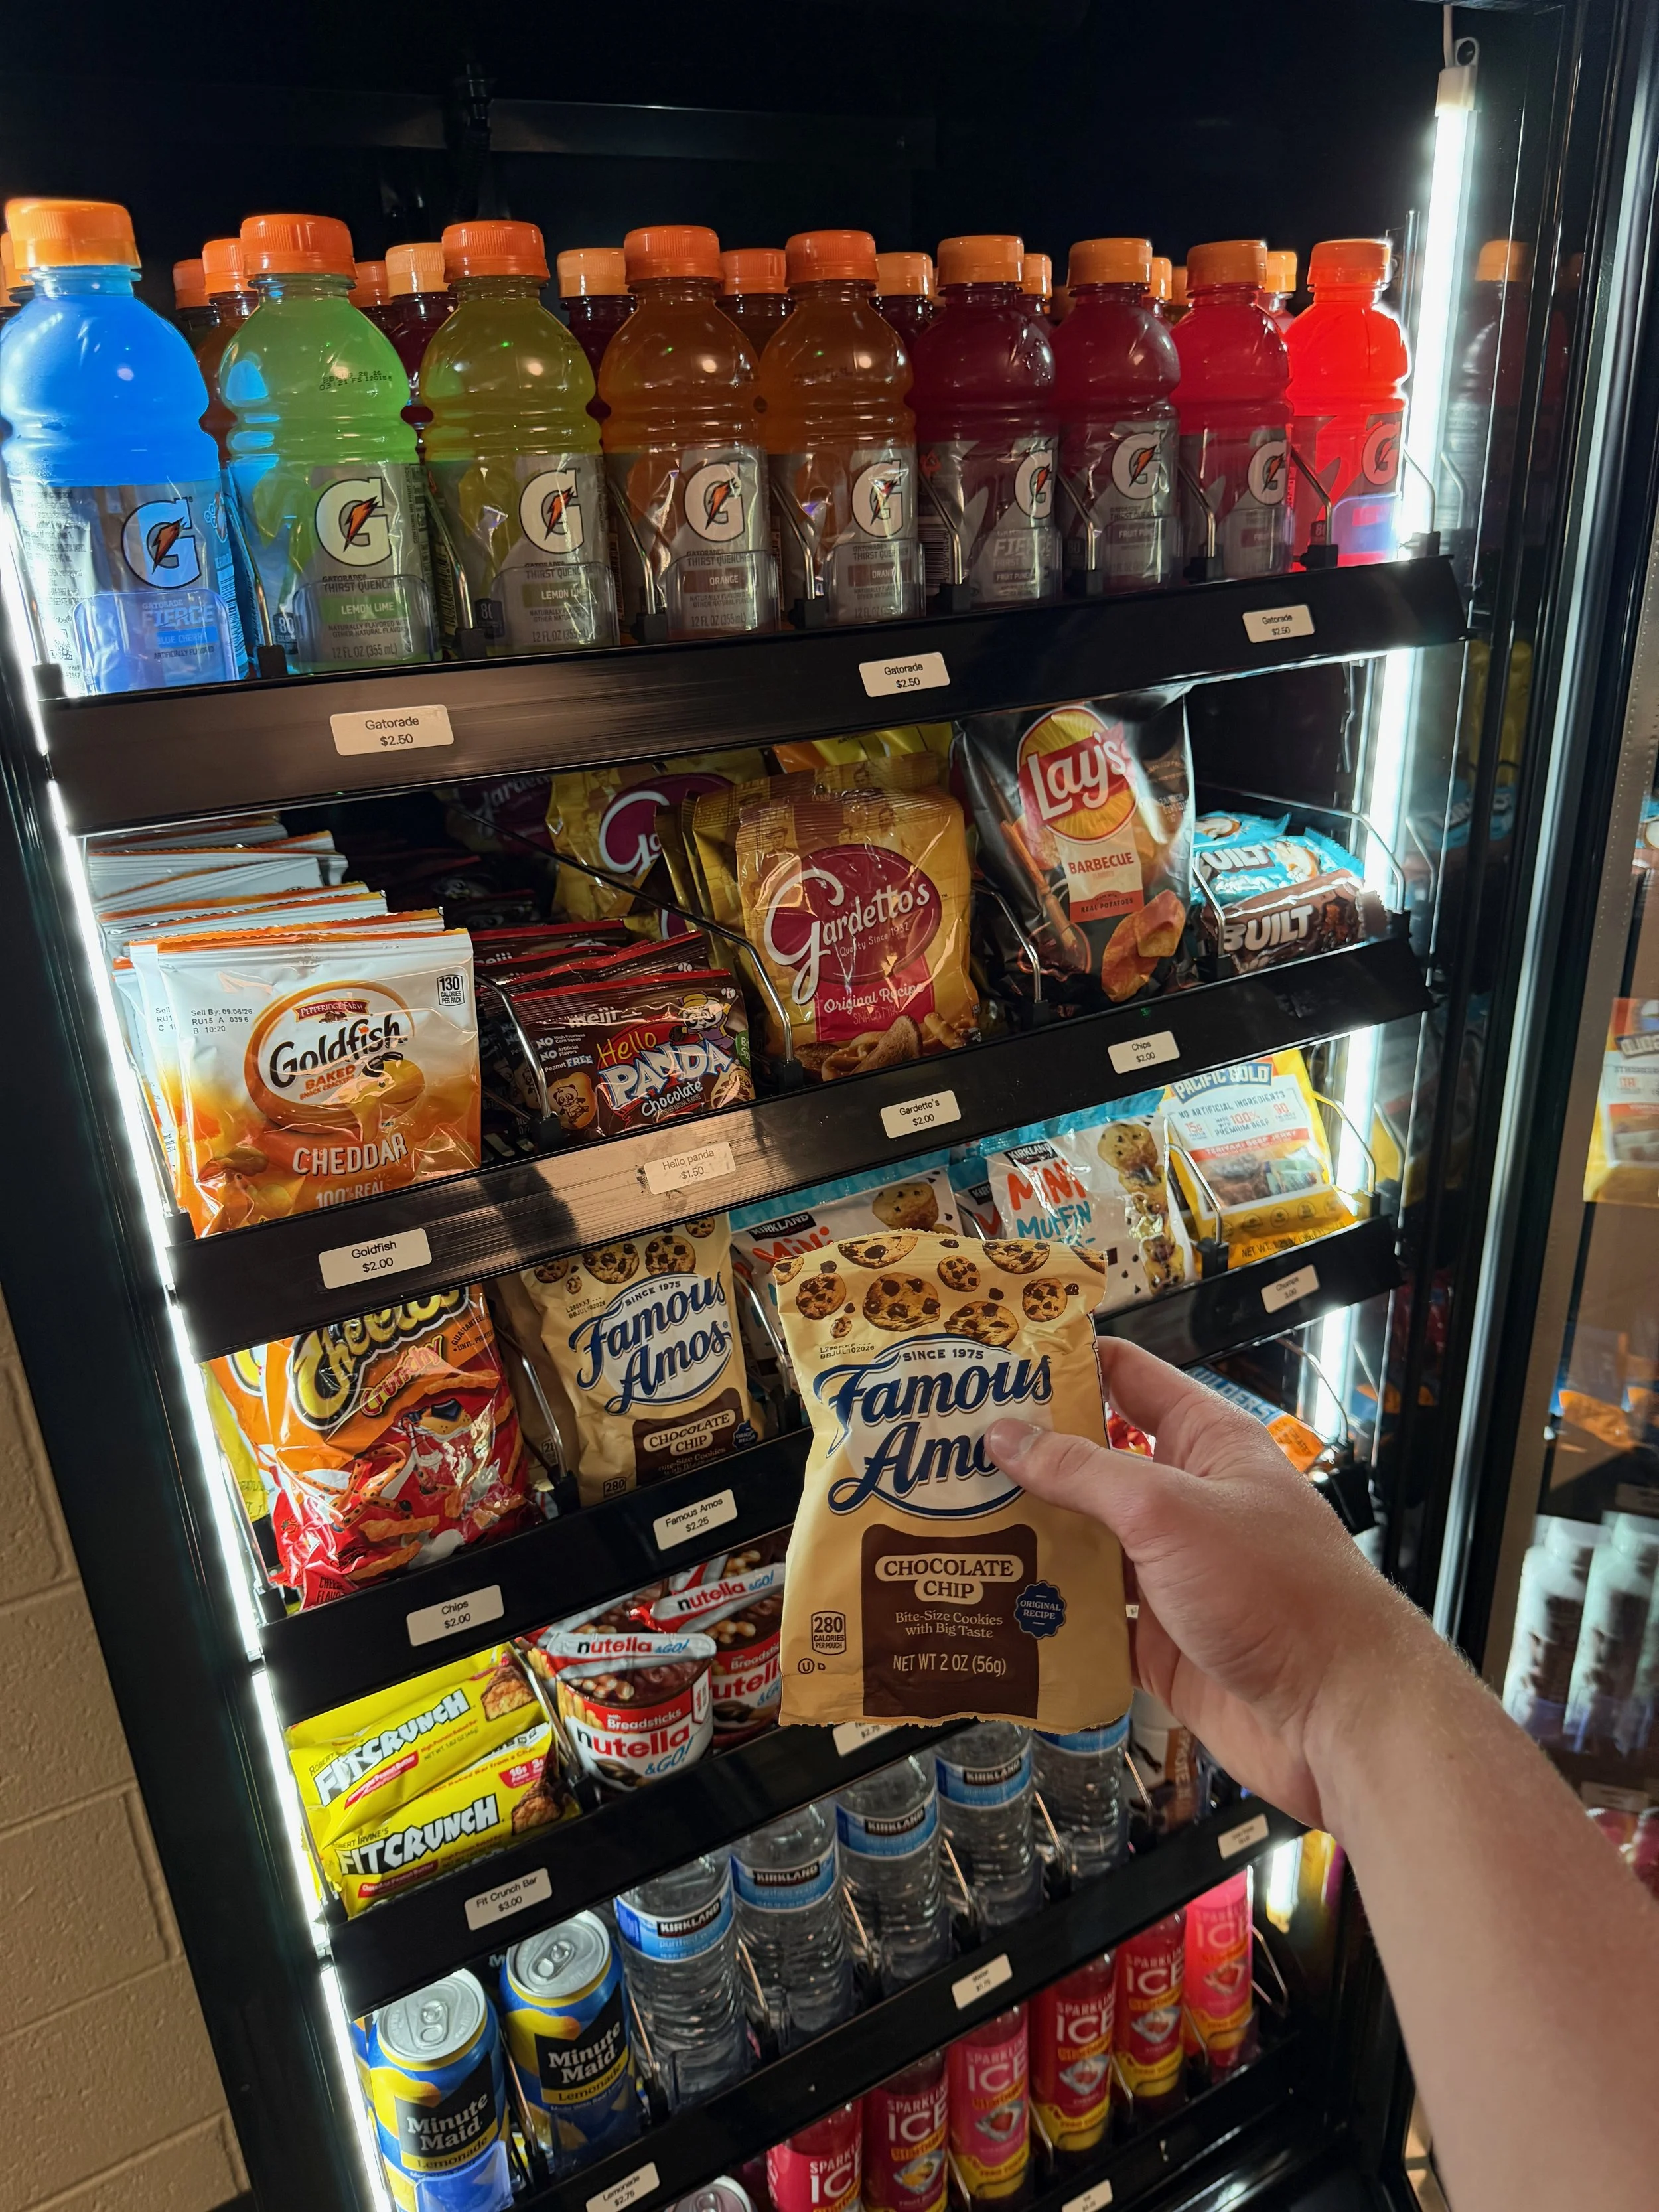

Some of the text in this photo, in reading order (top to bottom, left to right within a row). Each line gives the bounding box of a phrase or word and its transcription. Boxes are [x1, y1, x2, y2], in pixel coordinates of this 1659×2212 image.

[1112, 430, 1166, 500] G
[1014, 448, 1052, 520] G
[684, 461, 745, 542] G
[852, 459, 904, 538] G
[315, 477, 392, 566] G
[519, 468, 585, 554] G
[121, 496, 202, 589] G
[687, 556, 715, 567] THIRST
[324, 581, 354, 593] THIRST
[709, 575, 739, 585] ORANGE
[142, 599, 184, 609] GATORADE
[541, 590, 569, 600] LEMON
[141, 604, 216, 628] FIERCE
[341, 602, 394, 615] LEMON LIME
[329, 620, 394, 631] NATURALLY FLAVORED
[691, 615, 700, 626] 12
[1262, 614, 1293, 625] Gatorade
[331, 645, 364, 658] 12 FL OZ
[884, 662, 923, 676] Gatorade
[896, 677, 920, 689] $2.50
[365, 716, 419, 731] Gatorade
[380, 733, 413, 747] $2.50
[1027, 731, 1127, 820] Lay's
[1068, 852, 1135, 875] BARBECUE
[1081, 897, 1133, 913] REAL POTATOES
[762, 869, 930, 1007] Gardetto's
[867, 922, 910, 947] Since 1932
[1224, 904, 1314, 951] BUILT
[439, 976, 460, 991] 130
[300, 1000, 364, 1017] PEPPERIDGE FARM
[824, 989, 879, 1015] Original
[192, 1017, 213, 1026] RU15
[269, 1013, 404, 1089] Goldfish
[535, 1037, 554, 1049] NO
[540, 1044, 579, 1062] NO Artificial
[596, 1031, 657, 1067] Hello
[1131, 1041, 1153, 1052] Chips
[544, 1055, 595, 1073] Peanut FREE
[1135, 1051, 1156, 1063] $2.00
[304, 1063, 356, 1091] BAKED
[597, 1039, 733, 1110] PANDA
[1173, 1064, 1269, 1100] PACIFIC GOLD
[899, 1098, 941, 1118] Gardetto's
[1191, 1090, 1285, 1116] ARTIFICIAL INGREDIENTS
[912, 1112, 936, 1127] $2.00
[292, 1132, 409, 1177] CHEDDAR
[662, 1149, 715, 1171] Hello panda
[1007, 1142, 1052, 1159] KIRKLAND
[680, 1166, 705, 1181] $1.50
[355, 1179, 386, 1199] REAL
[751, 1213, 810, 1236] KIRKLAND
[350, 1239, 398, 1260] Goldfish
[1242, 1247, 1256, 1258] NET
[362, 1256, 395, 1274] $2.00
[624, 1280, 682, 1307] SINCE 1975
[568, 1270, 726, 1390] Famous
[903, 1349, 985, 1362] SINCE 1975
[360, 1334, 444, 1417] Crunchy
[604, 1320, 733, 1416] Amos
[812, 1353, 1054, 1461] Famous
[649, 1412, 731, 1449] CHOCOLATE
[675, 1434, 708, 1453] CHIP
[605, 1478, 626, 1493] 280
[665, 1497, 724, 1528] Famous Amos
[685, 1516, 710, 1532] $2.25
[883, 1558, 1015, 1578] CHOCOLATE
[677, 1570, 774, 1611] nutella &GO!
[923, 1580, 974, 1599] CHIP
[441, 1599, 469, 1615] Chips
[1019, 1599, 1062, 1613] ORIGINAL
[1023, 1609, 1057, 1621] RECIPE
[443, 1613, 472, 1630] $2.00
[814, 1616, 843, 1634] 280
[895, 1610, 1004, 1626] Bite-Size Cookies
[814, 1633, 845, 1643] CALORIES
[905, 1623, 993, 1639] with Big Taste
[577, 1637, 691, 1654] nutella &GO!
[826, 1641, 843, 1649] POUCH
[893, 1653, 1007, 1678] NET WT 2 OZ (56g)
[607, 1708, 682, 1730] Breadsticks
[313, 1688, 471, 1808] FITCRUNCH
[577, 1725, 690, 1758] nutella
[644, 1734, 693, 1777] &GO!
[966, 1761, 1021, 1782] KIRKLAND
[867, 1809, 924, 1832] KIRKLAND
[334, 1792, 500, 1876] FITCRUNCH
[358, 1826, 390, 1844] IRVINE'S
[755, 1864, 818, 1883] KIRKLAND
[476, 1876, 538, 1909] Fit Crunch Bar
[498, 1895, 523, 1913] $3.00
[659, 1903, 719, 1933] KIRKLAND
[1127, 1960, 1185, 1996] ICE
[1056, 2007, 1114, 2045] ICE
[547, 2020, 621, 2069] Minute
[561, 2045, 617, 2085] Maid
[968, 2054, 1026, 2093] ICE
[558, 2063, 622, 2102] Lemonade
[406, 2093, 488, 2134] Minute
[888, 2096, 948, 2142] ICE
[420, 2116, 482, 2151] Maid
[417, 2136, 488, 2168] Lemonade
[603, 2174, 641, 2203] Lemonade
